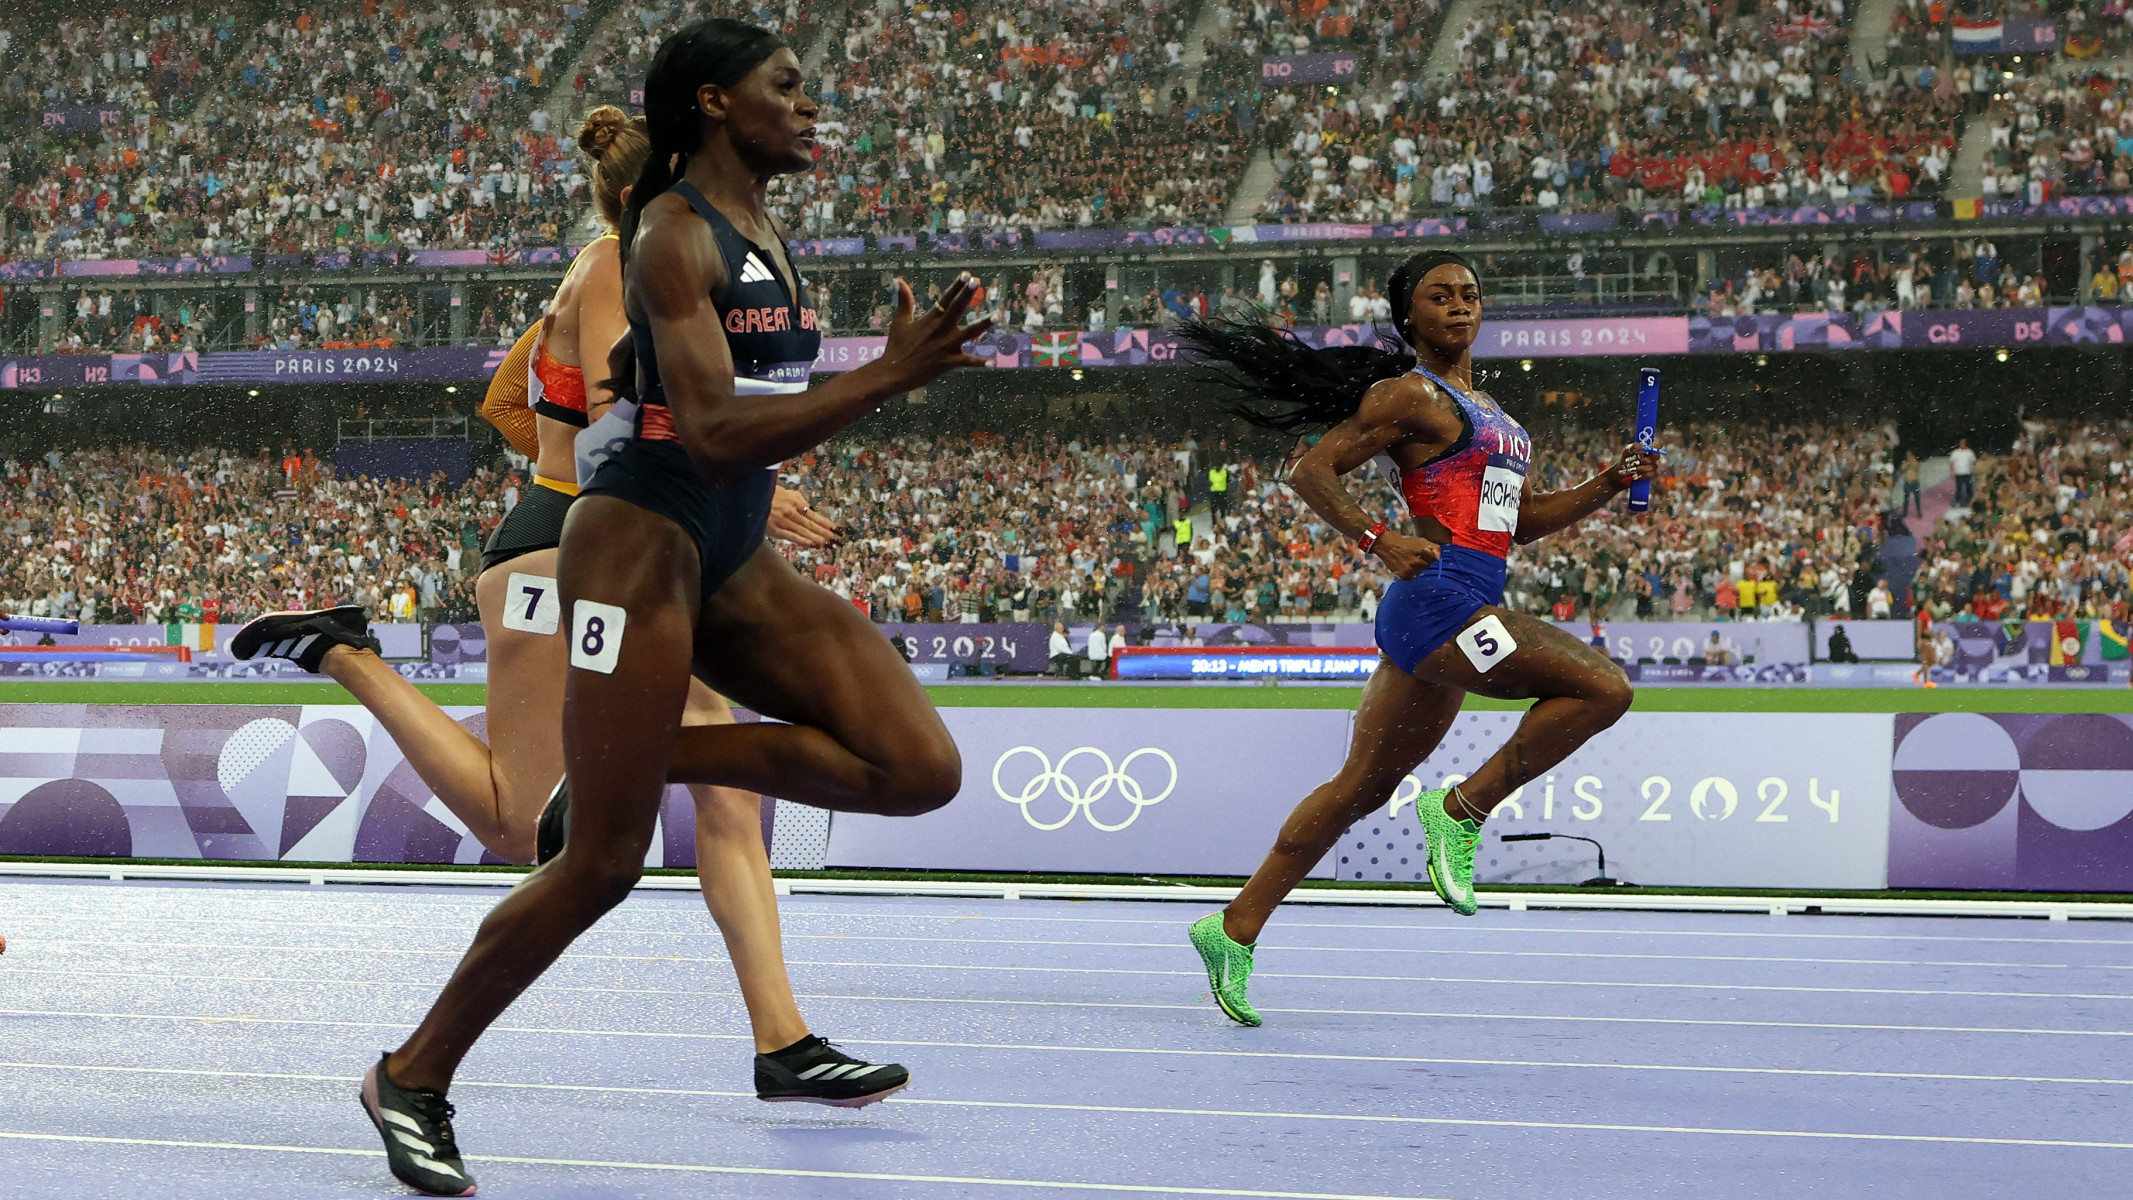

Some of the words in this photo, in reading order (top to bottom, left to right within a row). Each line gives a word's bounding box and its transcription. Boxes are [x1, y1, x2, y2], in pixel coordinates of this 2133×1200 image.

[726, 307, 791, 333] GREAT
[1501, 329, 1572, 347] PARIS
[1581, 327, 1646, 347] 2024
[2014, 321, 2044, 341] D5
[19, 367, 42, 383] H3
[85, 366, 108, 382] H2
[275, 358, 335, 374] PARIS
[343, 357, 399, 373] 2024
[522, 585, 545, 621] 7
[581, 616, 605, 656] 8
[1473, 628, 1499, 656] 5
[932, 636, 1016, 659] 2024
[1191, 659, 1228, 673] 20:13
[1279, 659, 1322, 673] TRIPLE
[1323, 659, 1360, 674] JUMP
[1639, 775, 1839, 824] 2024
